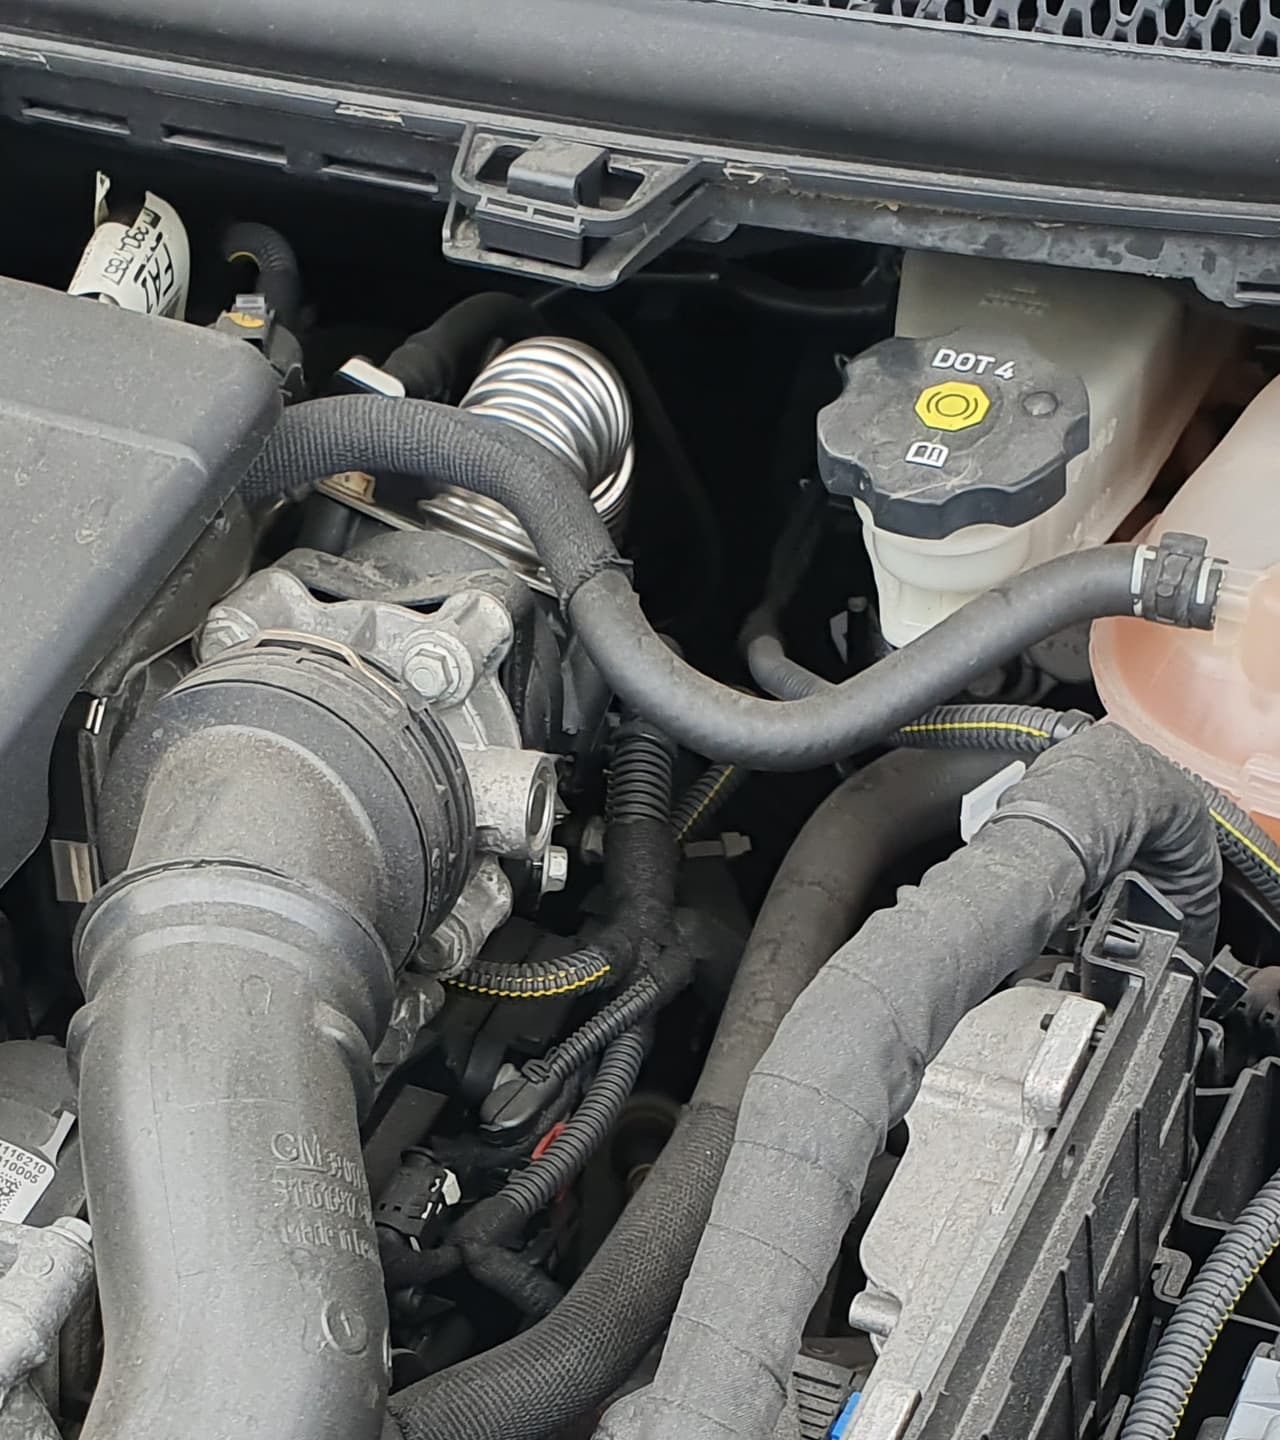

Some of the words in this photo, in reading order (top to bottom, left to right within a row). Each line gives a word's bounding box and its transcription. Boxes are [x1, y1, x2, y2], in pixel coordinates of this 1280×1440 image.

[931, 348, 997, 374] DOT
[993, 360, 1016, 381] 4
[271, 1131, 323, 1166] GM
